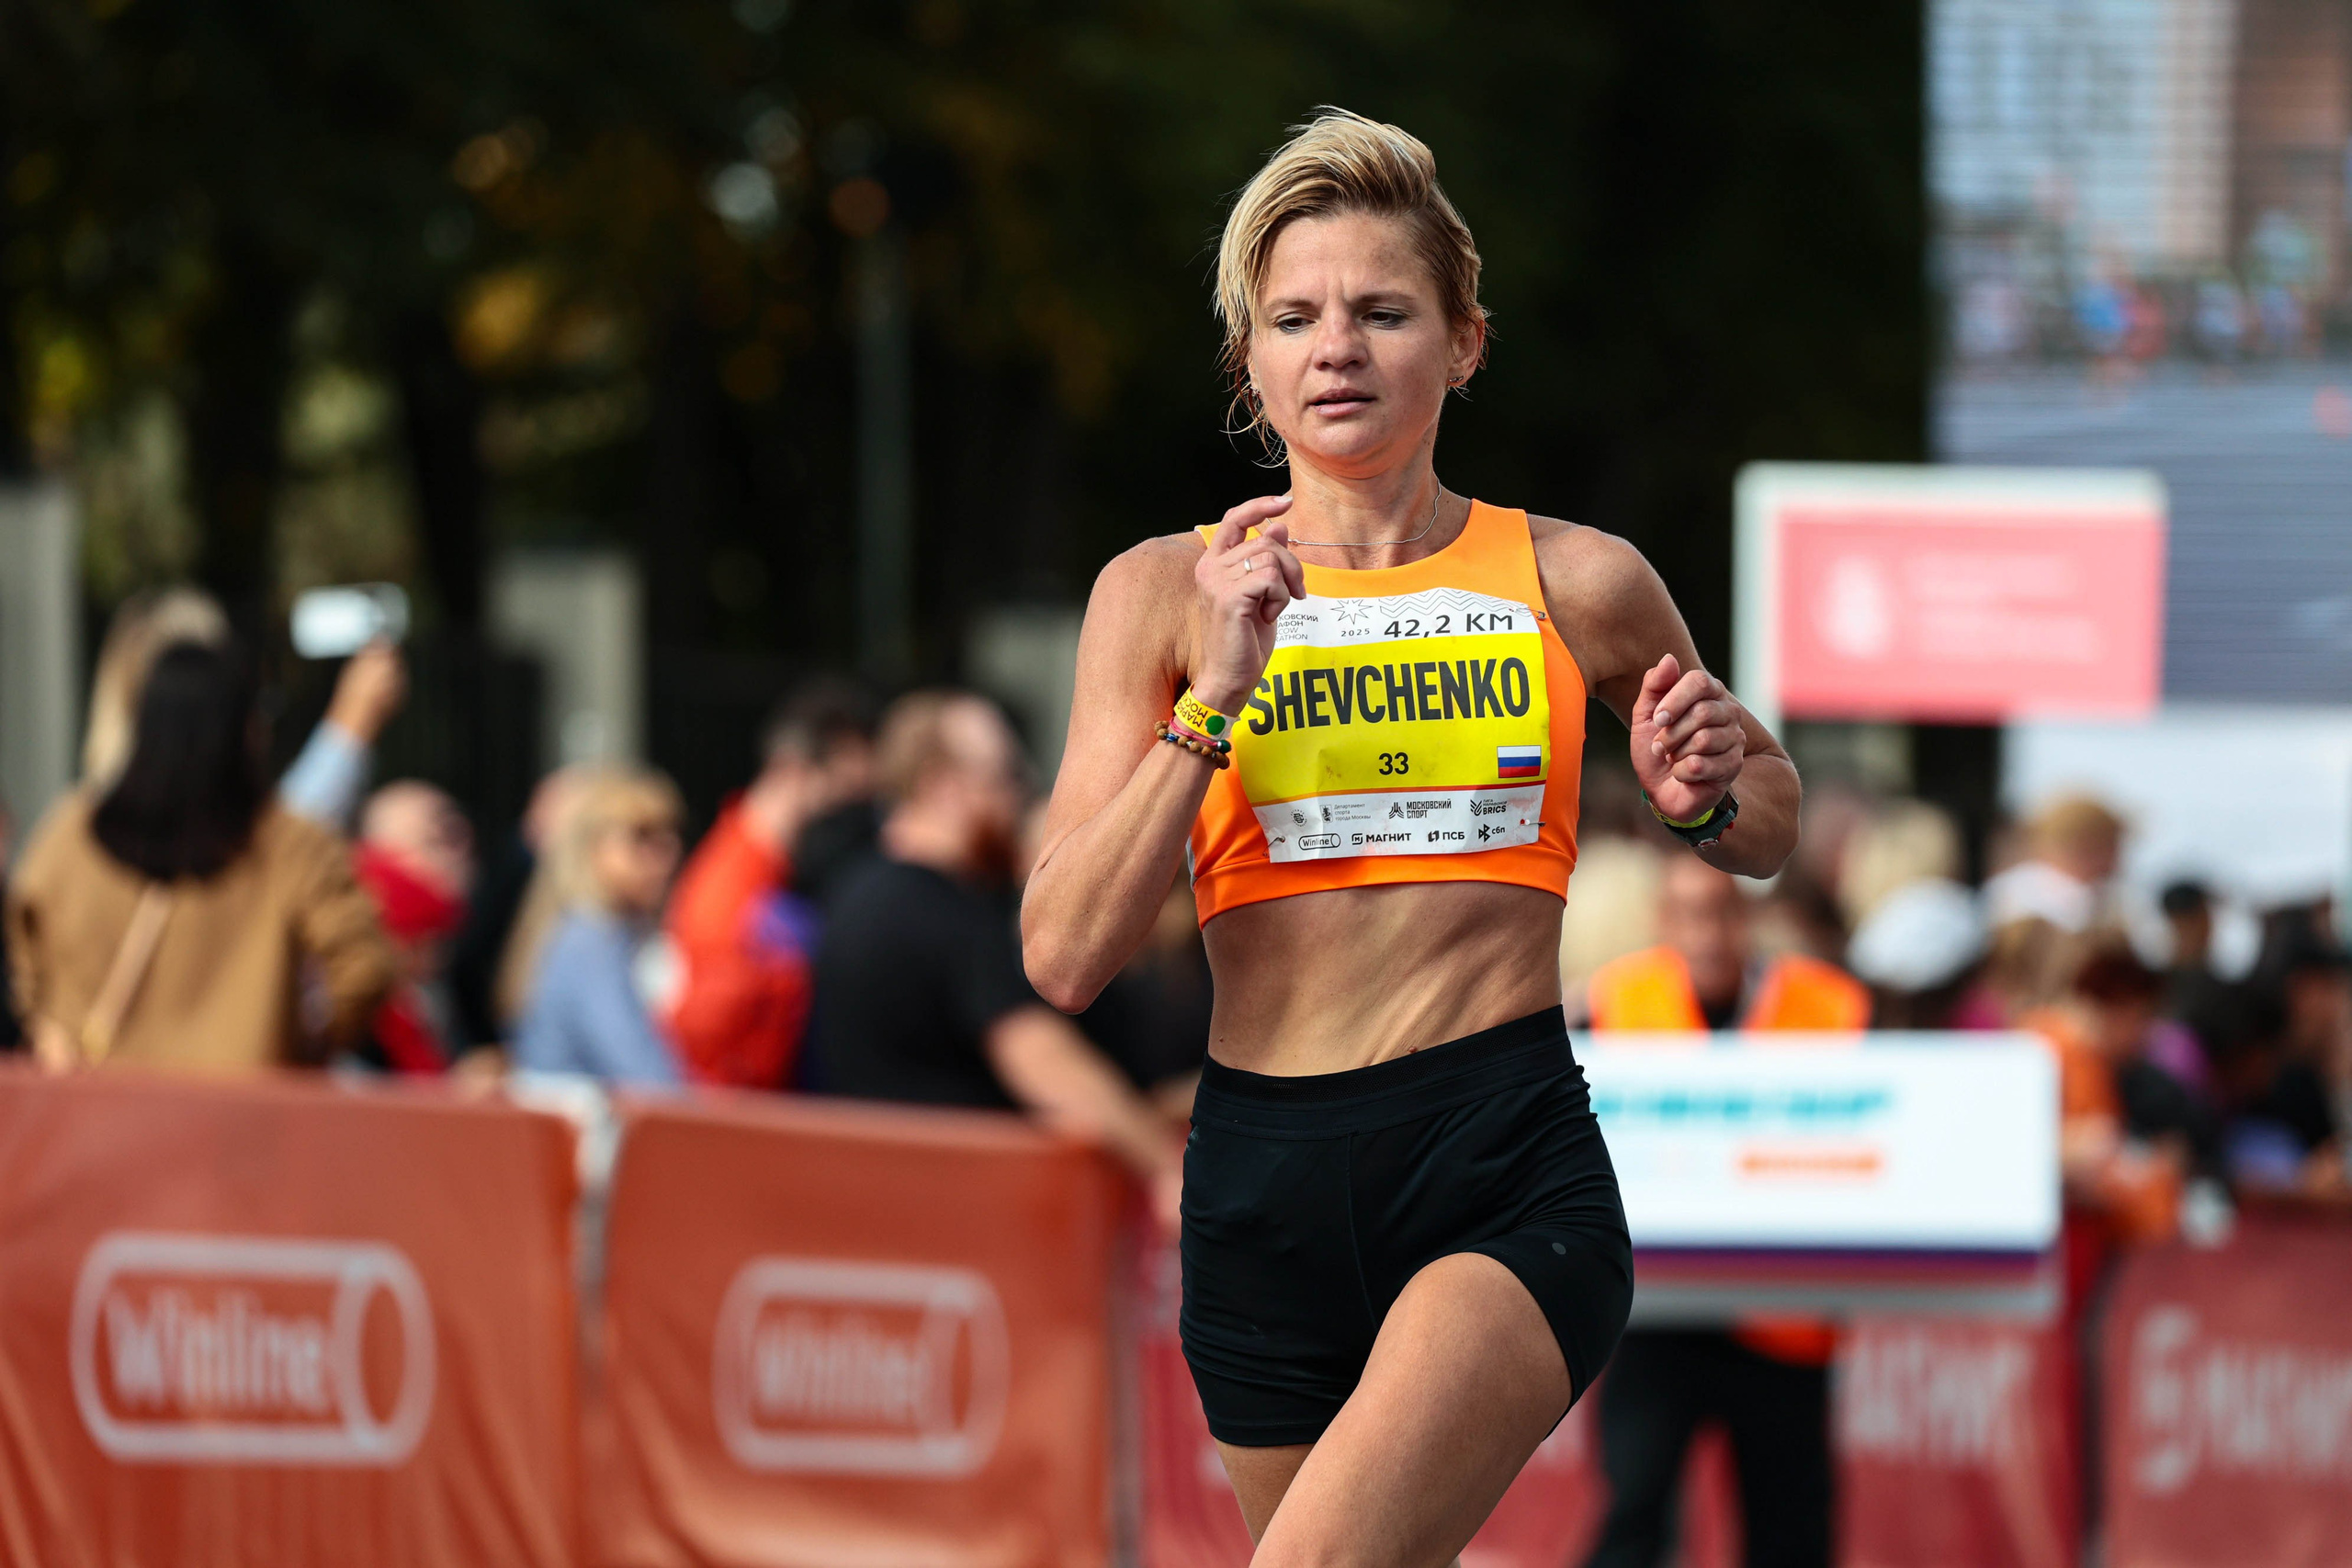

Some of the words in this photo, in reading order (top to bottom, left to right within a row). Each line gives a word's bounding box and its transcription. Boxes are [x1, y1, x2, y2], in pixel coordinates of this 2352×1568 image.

[1278, 614, 1318, 623] КОВСКИЙ
[1277, 620, 1304, 628] АФОН
[1384, 615, 1451, 638] 42,2
[1340, 628, 1371, 637] 2025
[1275, 634, 1308, 642] RATHON
[1247, 657, 1531, 736] SHEVCHENKO
[1378, 751, 1409, 775] 33
[1406, 798, 1452, 810] МОСКОВСКИЙ
[1407, 810, 1428, 818] СПОРТ
[1483, 805, 1507, 815] BRICS
[1491, 826, 1506, 835] сбп
[1366, 832, 1411, 843] МАГНИТ
[1442, 831, 1465, 840] ПСБ
[1302, 838, 1329, 847] Winline
